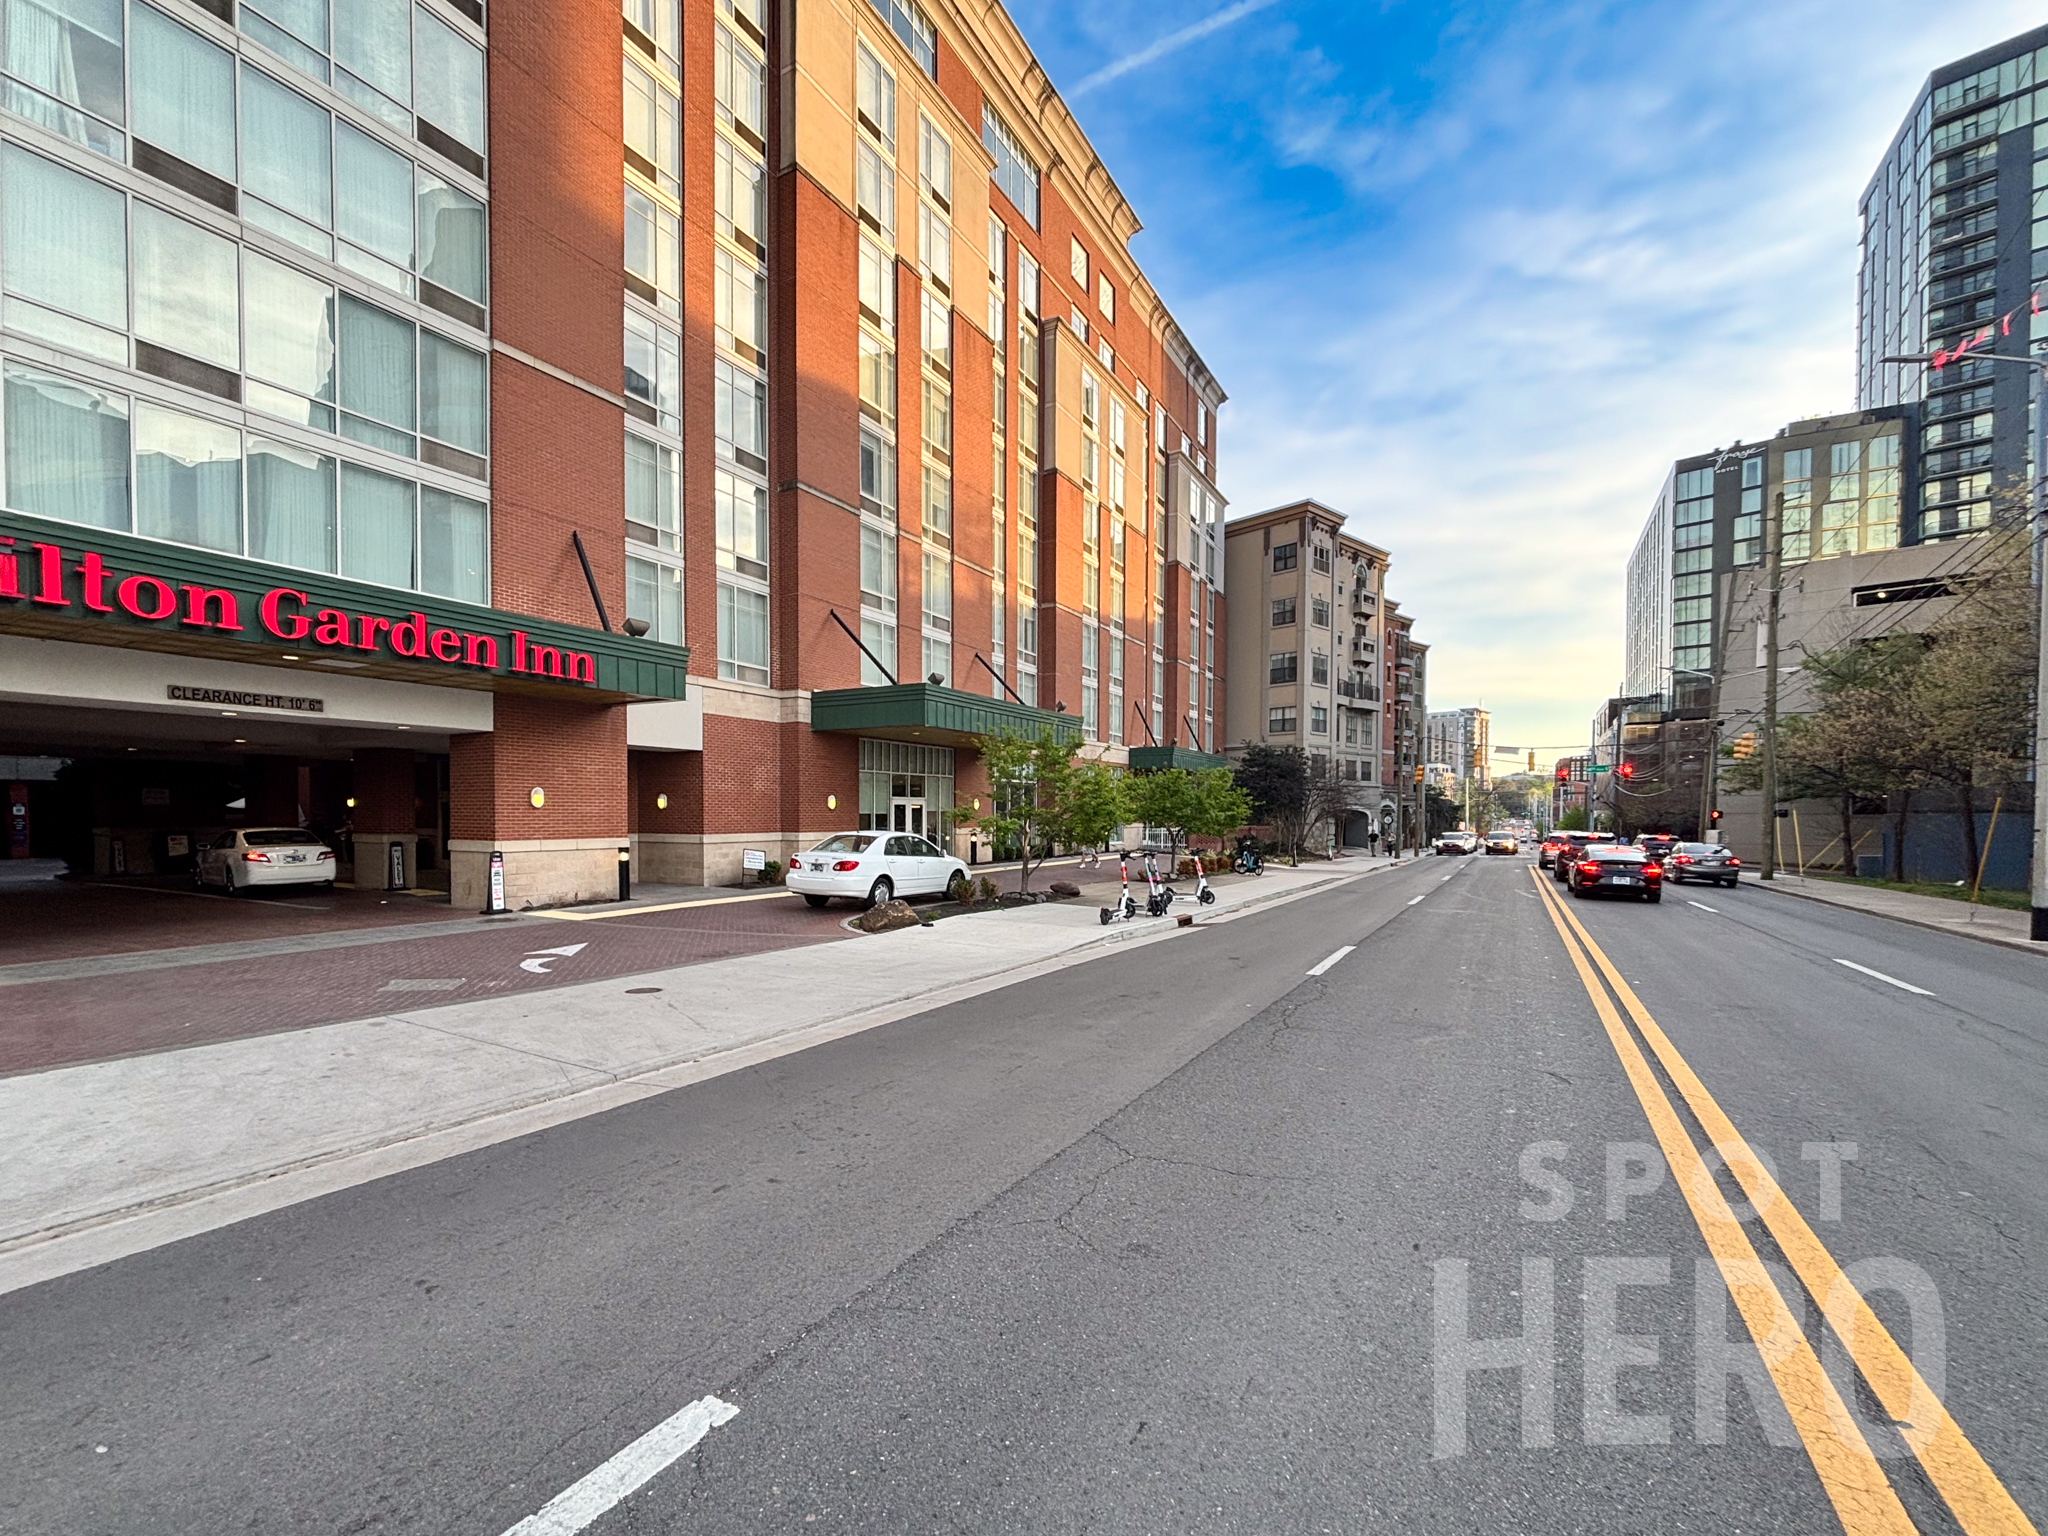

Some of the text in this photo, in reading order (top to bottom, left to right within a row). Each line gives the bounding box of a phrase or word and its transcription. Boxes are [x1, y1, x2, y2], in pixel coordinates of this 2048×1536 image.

[260, 587, 499, 669] Garden
[510, 630, 597, 683] Inn
[171, 686, 261, 706] CLEARANCE
[265, 694, 285, 708] HT.
[289, 697, 305, 709] 10'
